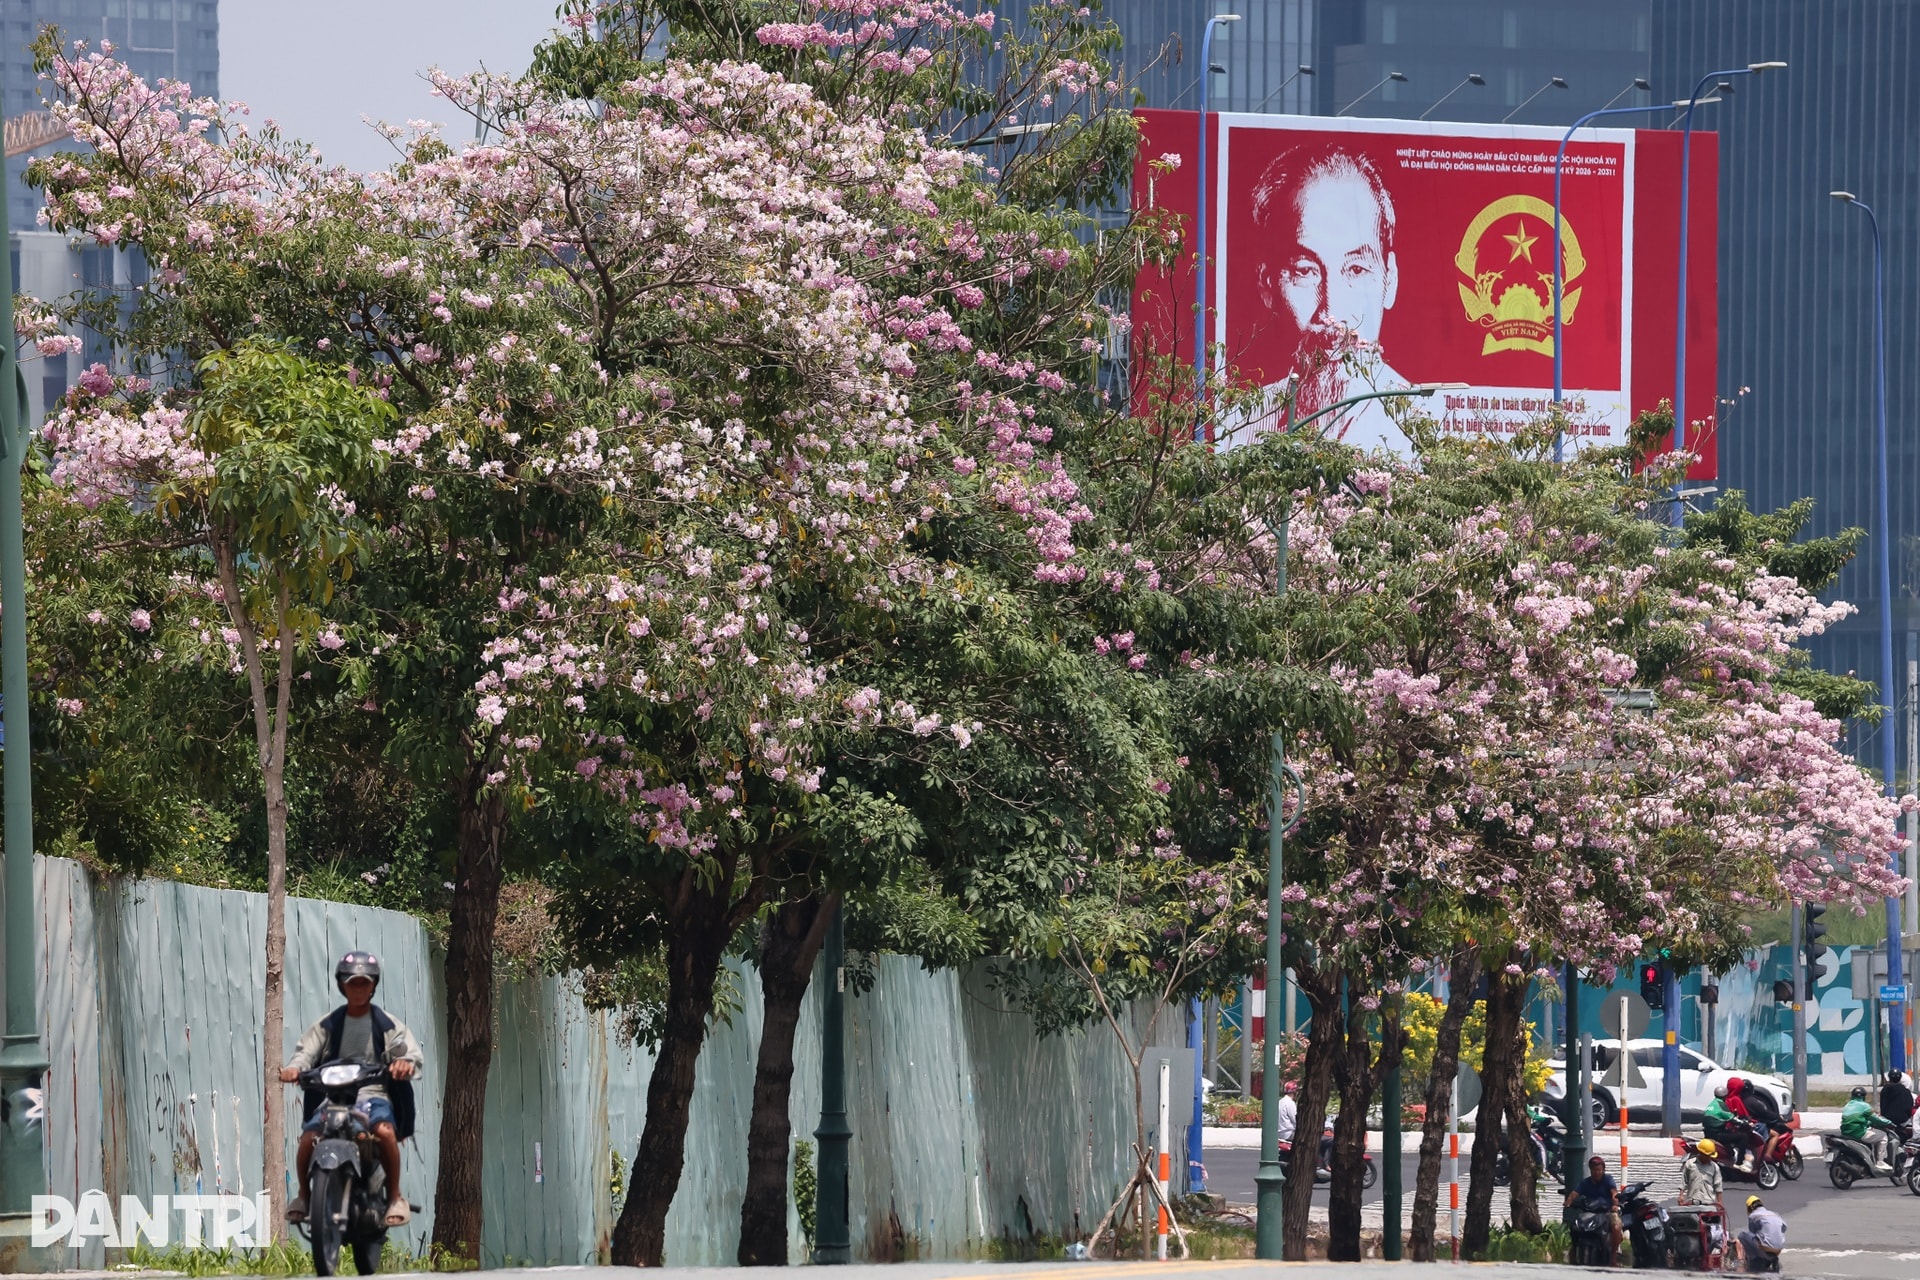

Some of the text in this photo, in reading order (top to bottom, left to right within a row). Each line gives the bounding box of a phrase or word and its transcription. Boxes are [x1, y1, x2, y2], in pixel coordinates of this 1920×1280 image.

[1396, 148, 1415, 158] NHIỆT
[1416, 148, 1430, 159] LIỆT
[1431, 149, 1451, 159] CHÀO
[1474, 151, 1492, 160] NGÀY
[1571, 154, 1583, 165] HỘI
[1605, 157, 1617, 166] XVI
[1400, 158, 1410, 168] VÀ
[1440, 161, 1452, 171] HỘI
[1496, 163, 1511, 173] DÂN
[1511, 163, 1526, 173] CÁC
[1543, 165, 1564, 175] NHIM
[1501, 328, 1538, 338] VIỆT NAM
